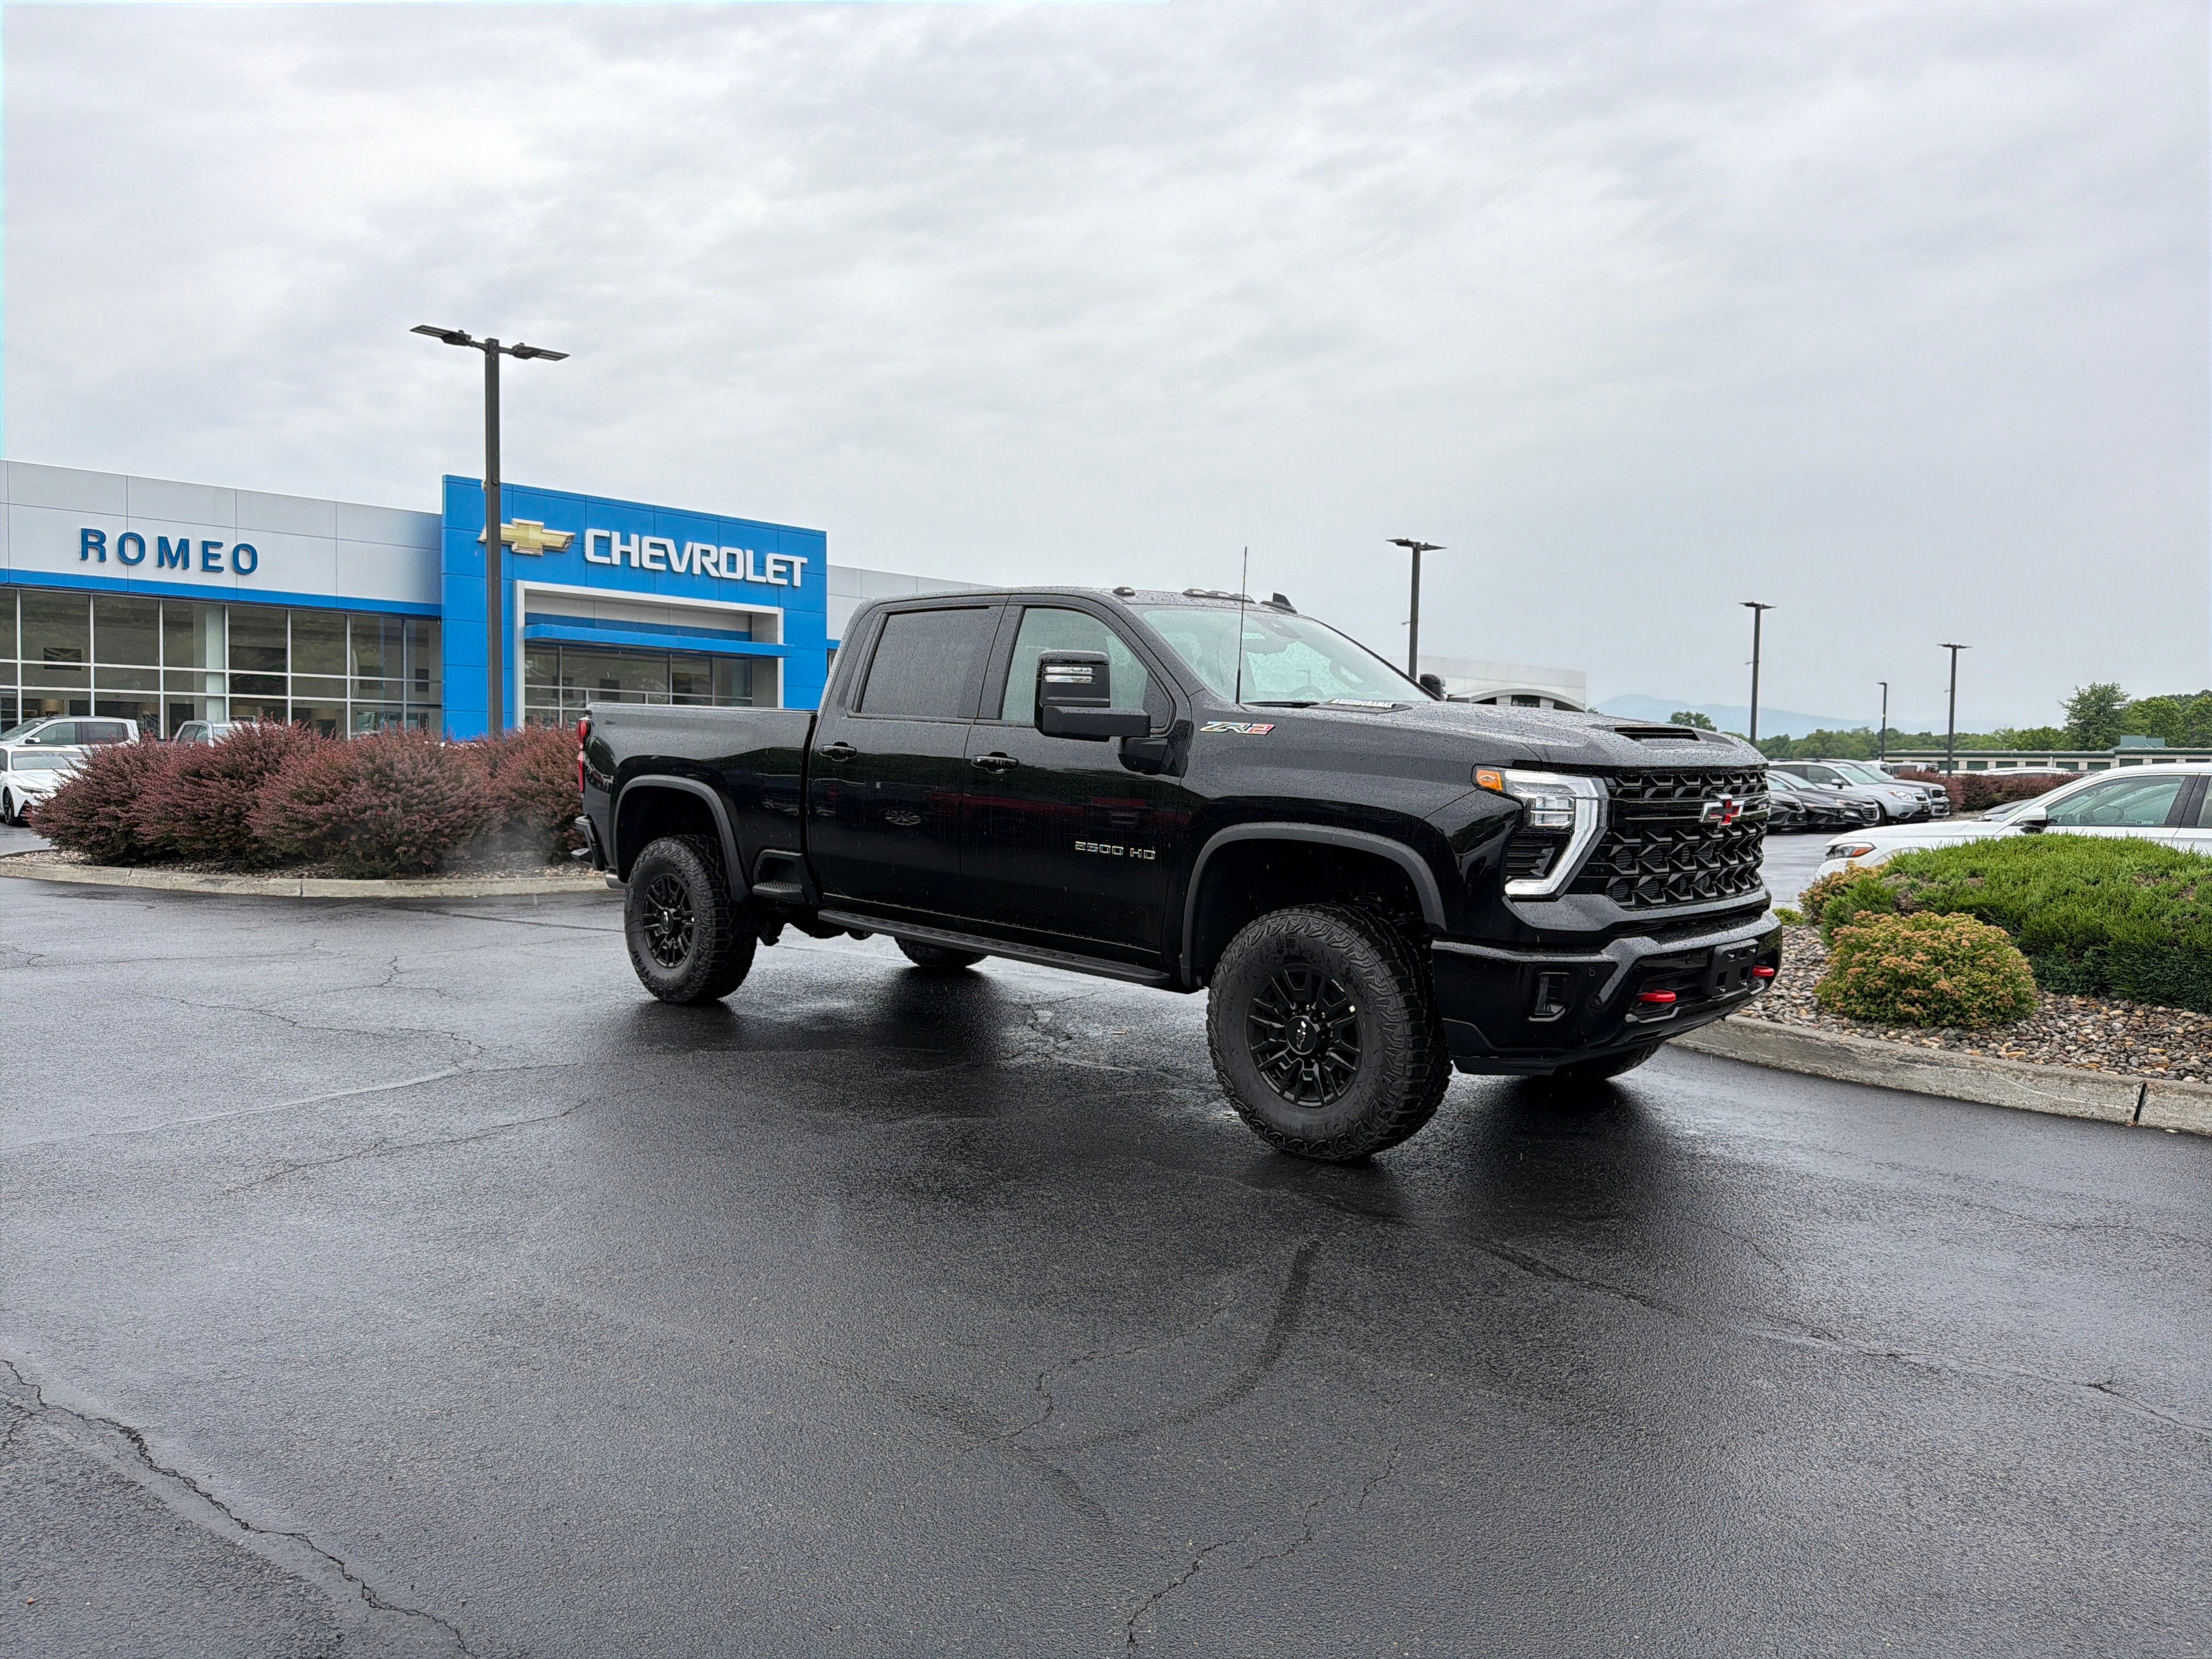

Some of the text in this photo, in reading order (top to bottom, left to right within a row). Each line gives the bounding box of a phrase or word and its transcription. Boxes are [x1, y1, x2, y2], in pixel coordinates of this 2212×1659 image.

[80, 528, 258, 574] ROMEO
[585, 528, 808, 586] CHEVROLET
[1356, 699, 1393, 708] DURAMAX
[1200, 721, 1276, 735] ZR2
[1075, 841, 1156, 860] 2500 HD
